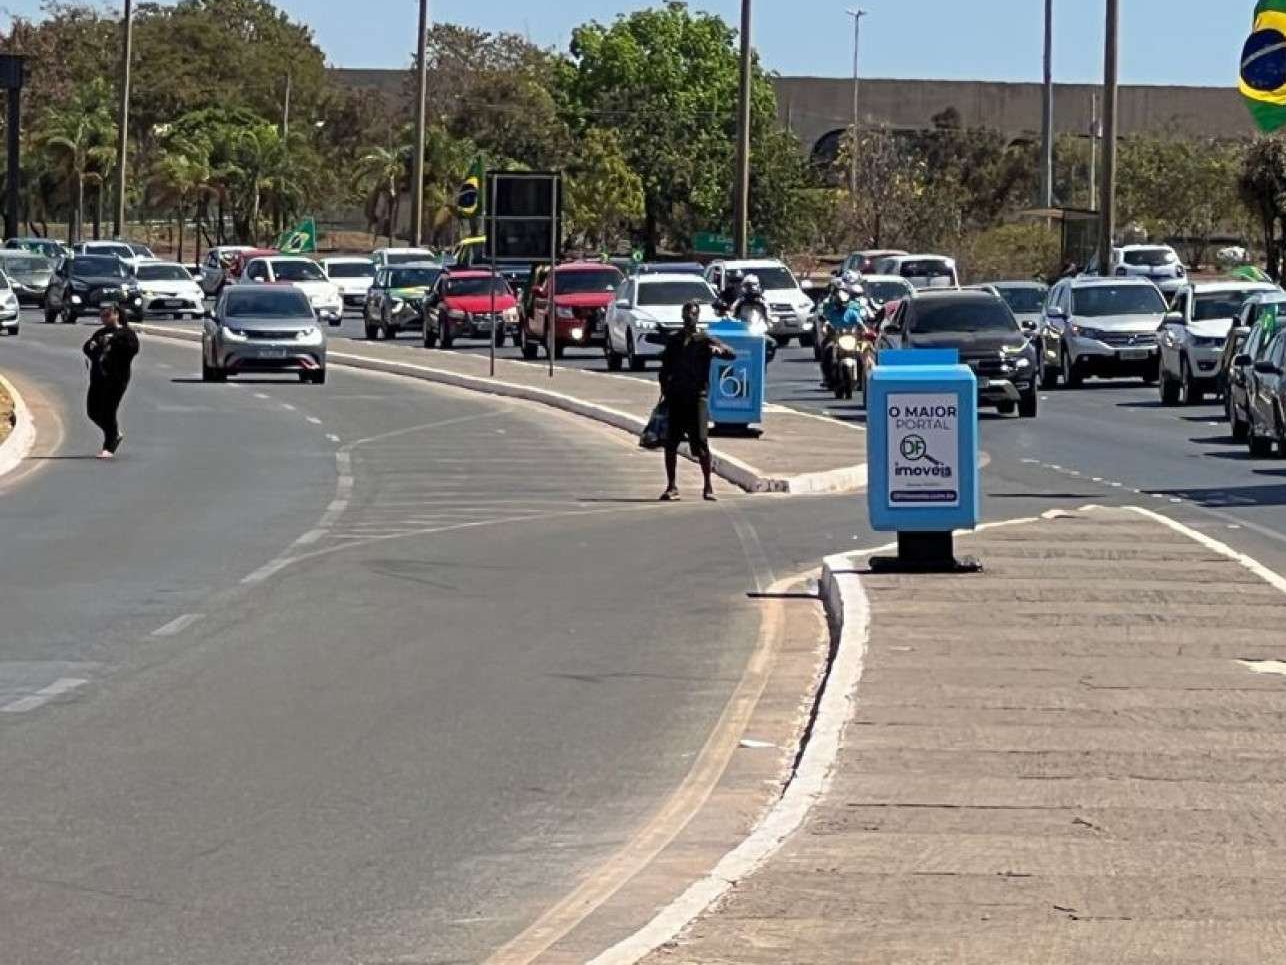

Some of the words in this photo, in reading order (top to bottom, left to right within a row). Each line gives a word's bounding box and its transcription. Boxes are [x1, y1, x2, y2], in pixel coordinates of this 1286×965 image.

[889, 406, 901, 417] O
[905, 406, 957, 417] MAIOR
[896, 419, 951, 430] PORTAL
